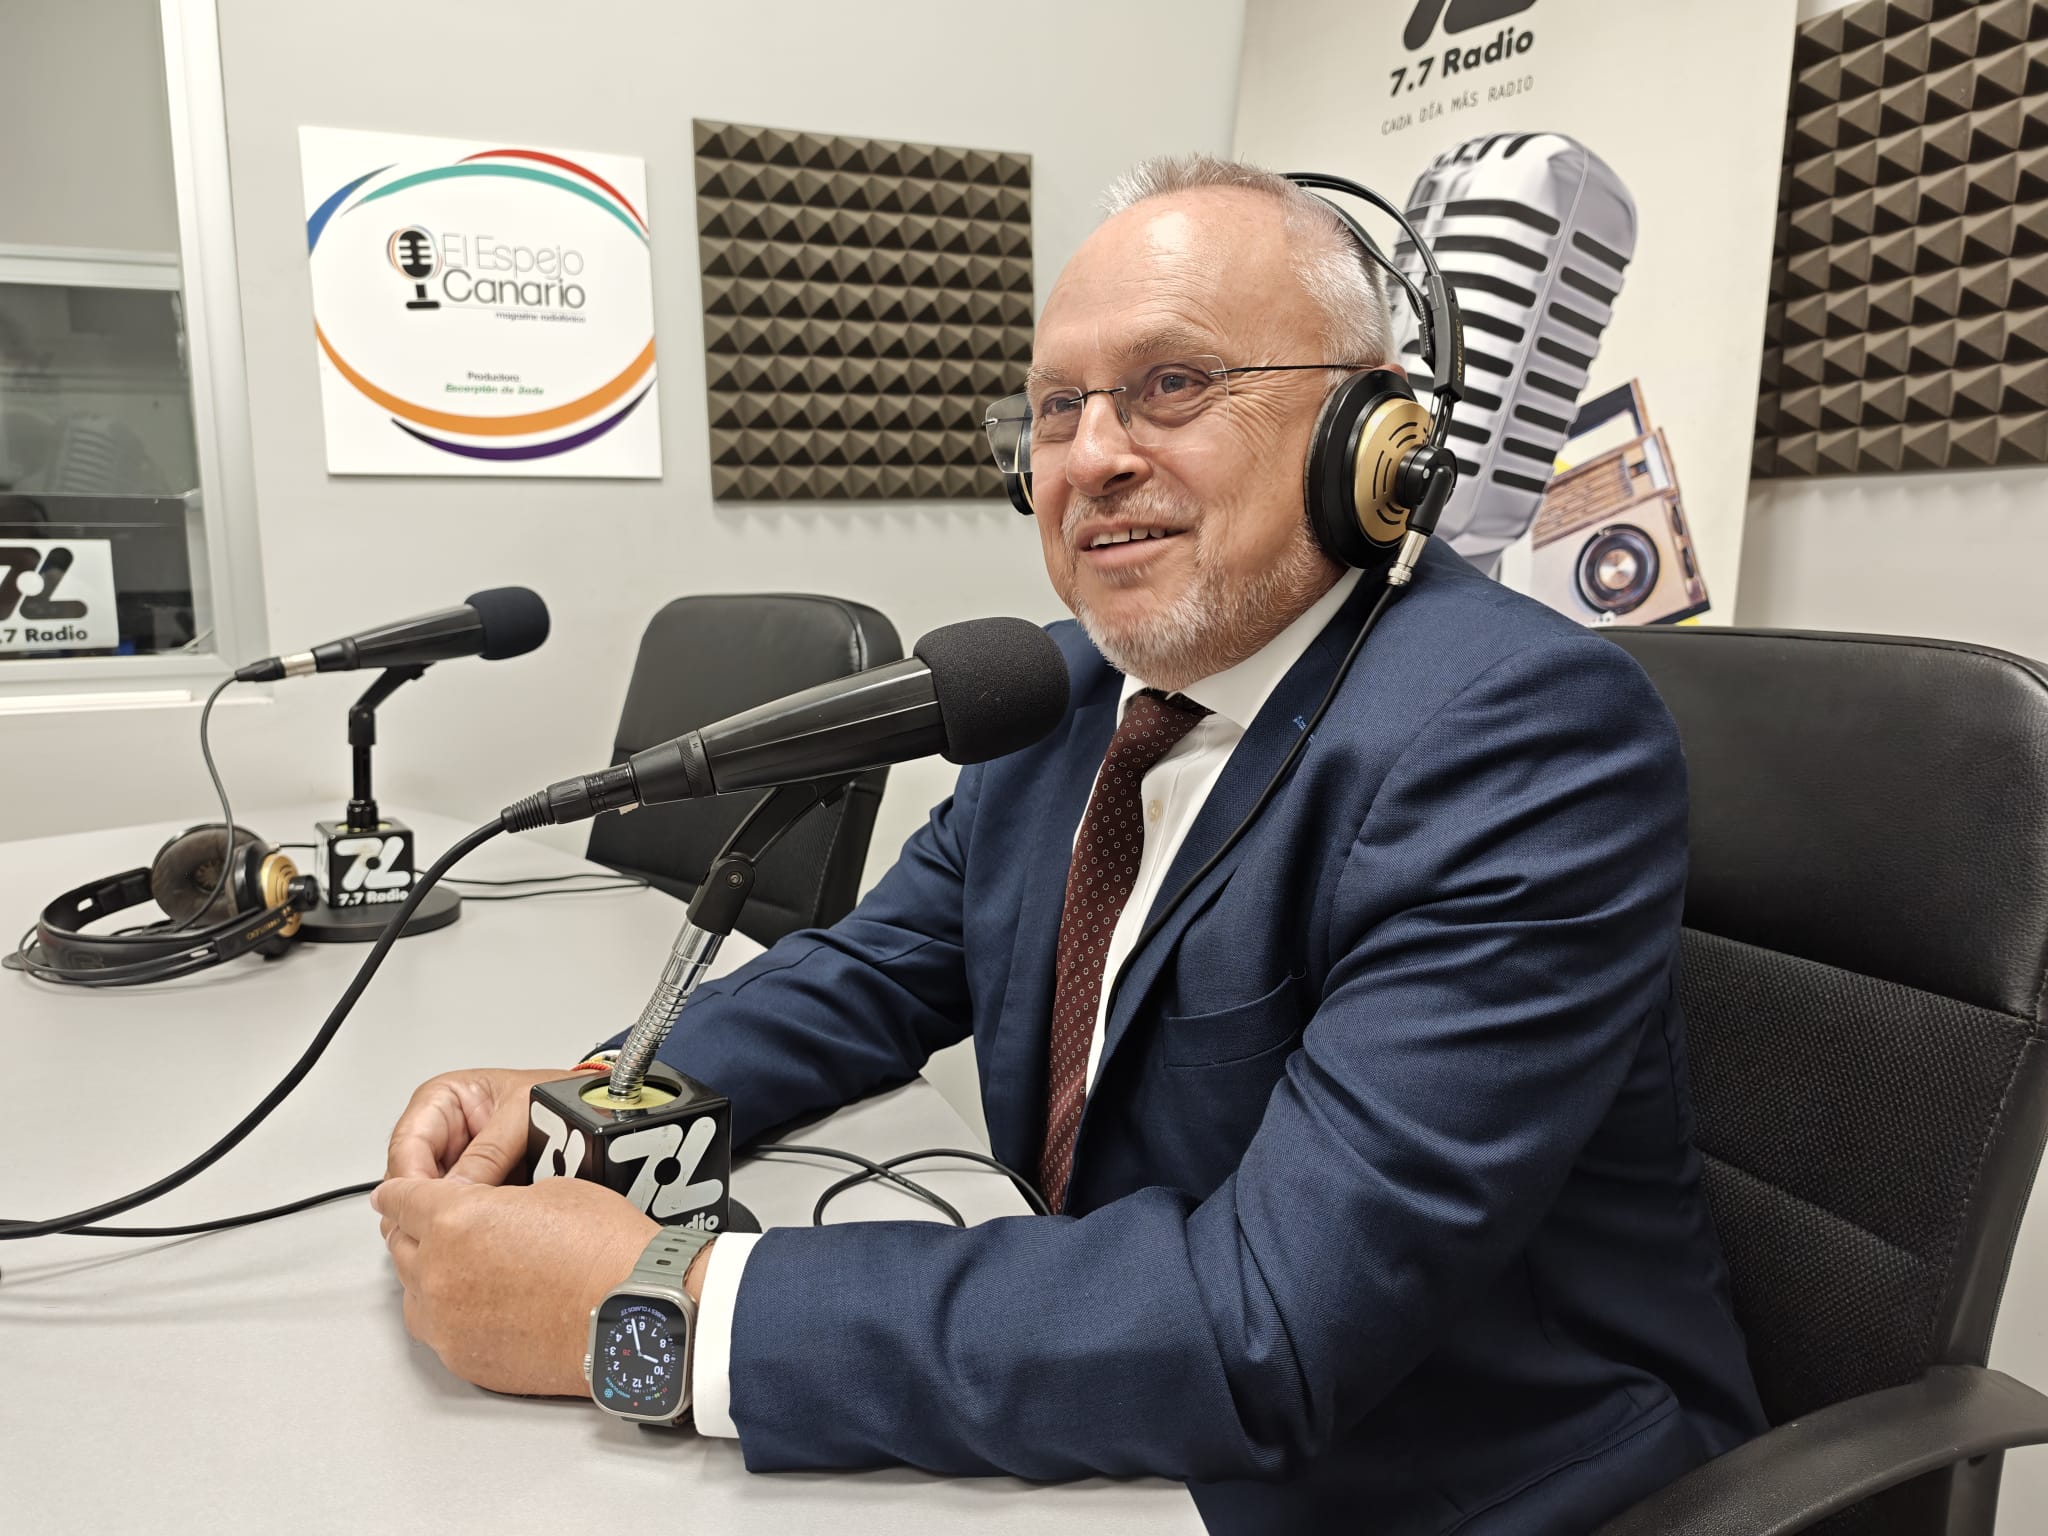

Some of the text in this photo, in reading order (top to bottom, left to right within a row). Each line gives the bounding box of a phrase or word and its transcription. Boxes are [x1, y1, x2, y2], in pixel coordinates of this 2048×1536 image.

[1389, 27, 1534, 97] 7.7 Radio
[1381, 74, 1534, 135] CADA DÍA MÁS RADIO
[441, 232, 584, 281] El Espejo
[442, 268, 586, 309] Canario
[25, 625, 88, 643] Radio
[337, 888, 409, 906] 7.7 Radio
[626, 1324, 633, 1334] 5
[639, 1321, 646, 1331] 6
[651, 1328, 657, 1337] 7
[615, 1333, 622, 1343] 4
[659, 1338, 667, 1349] 8
[609, 1346, 617, 1356] 3
[663, 1353, 670, 1363] 9
[613, 1361, 620, 1371] 2
[653, 1365, 664, 1376] 10
[622, 1372, 628, 1382] 1
[645, 1374, 654, 1385] 11
[632, 1378, 642, 1388] 12
